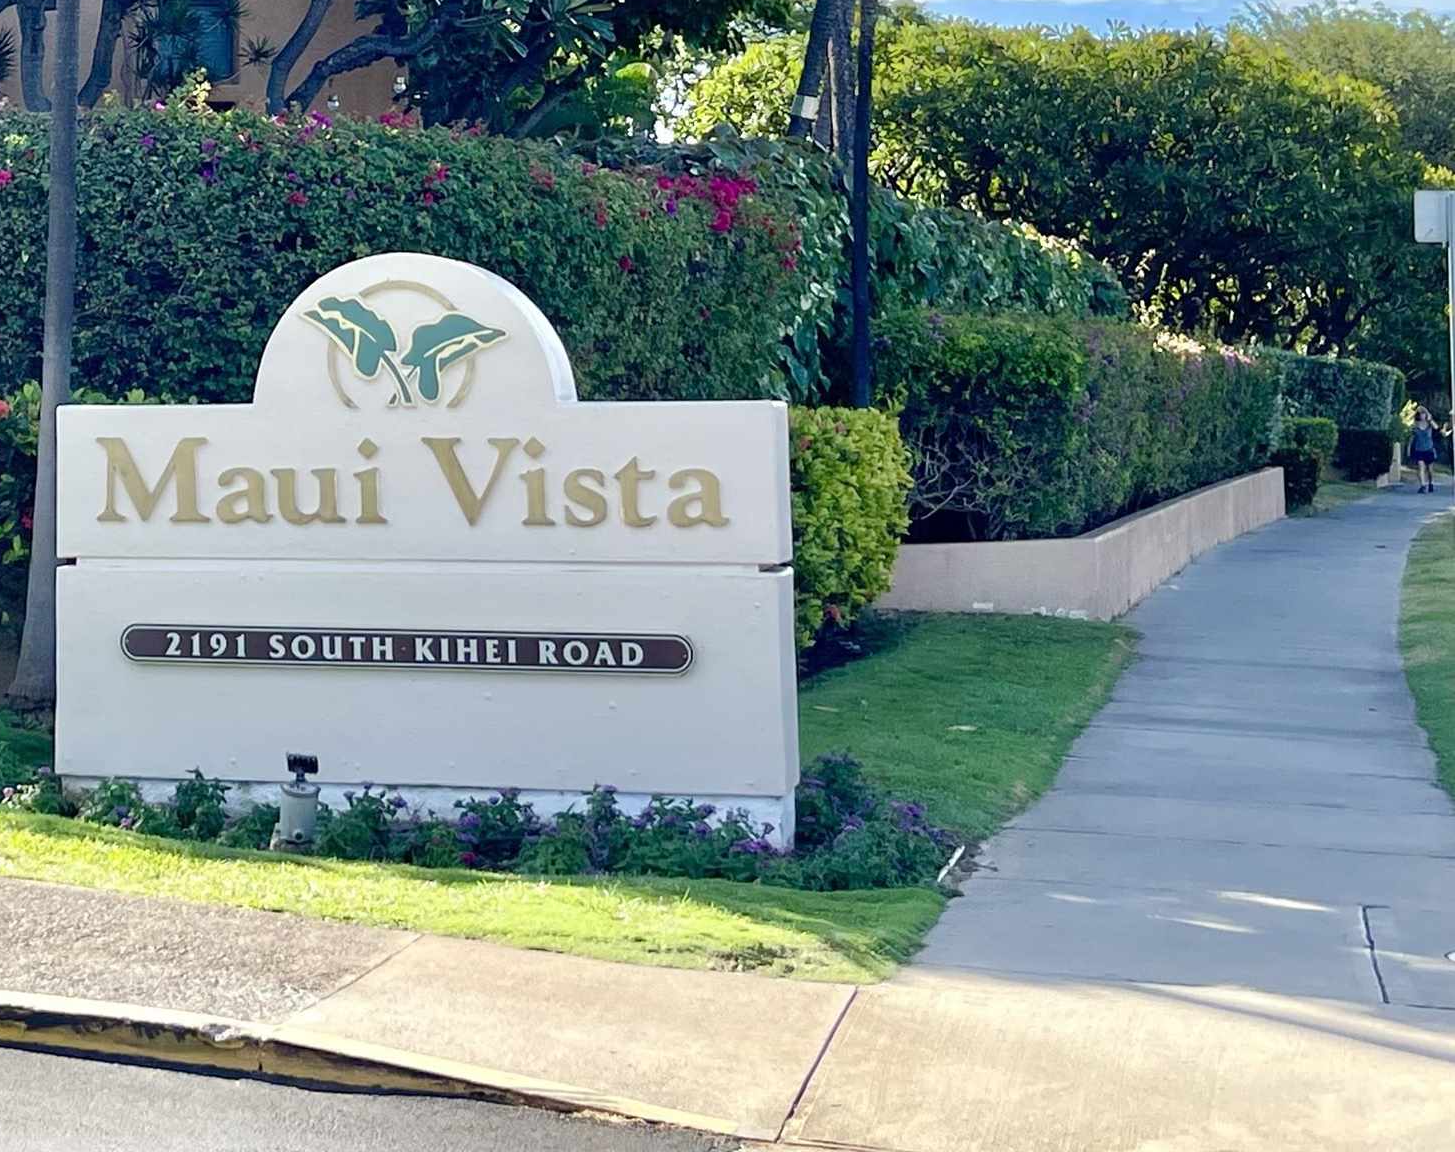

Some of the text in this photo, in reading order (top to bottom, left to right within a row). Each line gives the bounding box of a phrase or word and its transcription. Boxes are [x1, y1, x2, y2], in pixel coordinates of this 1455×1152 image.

[96, 437, 731, 529] Maui Vista
[165, 631, 645, 667] 2191 SOUTH KIHEI ROAD
